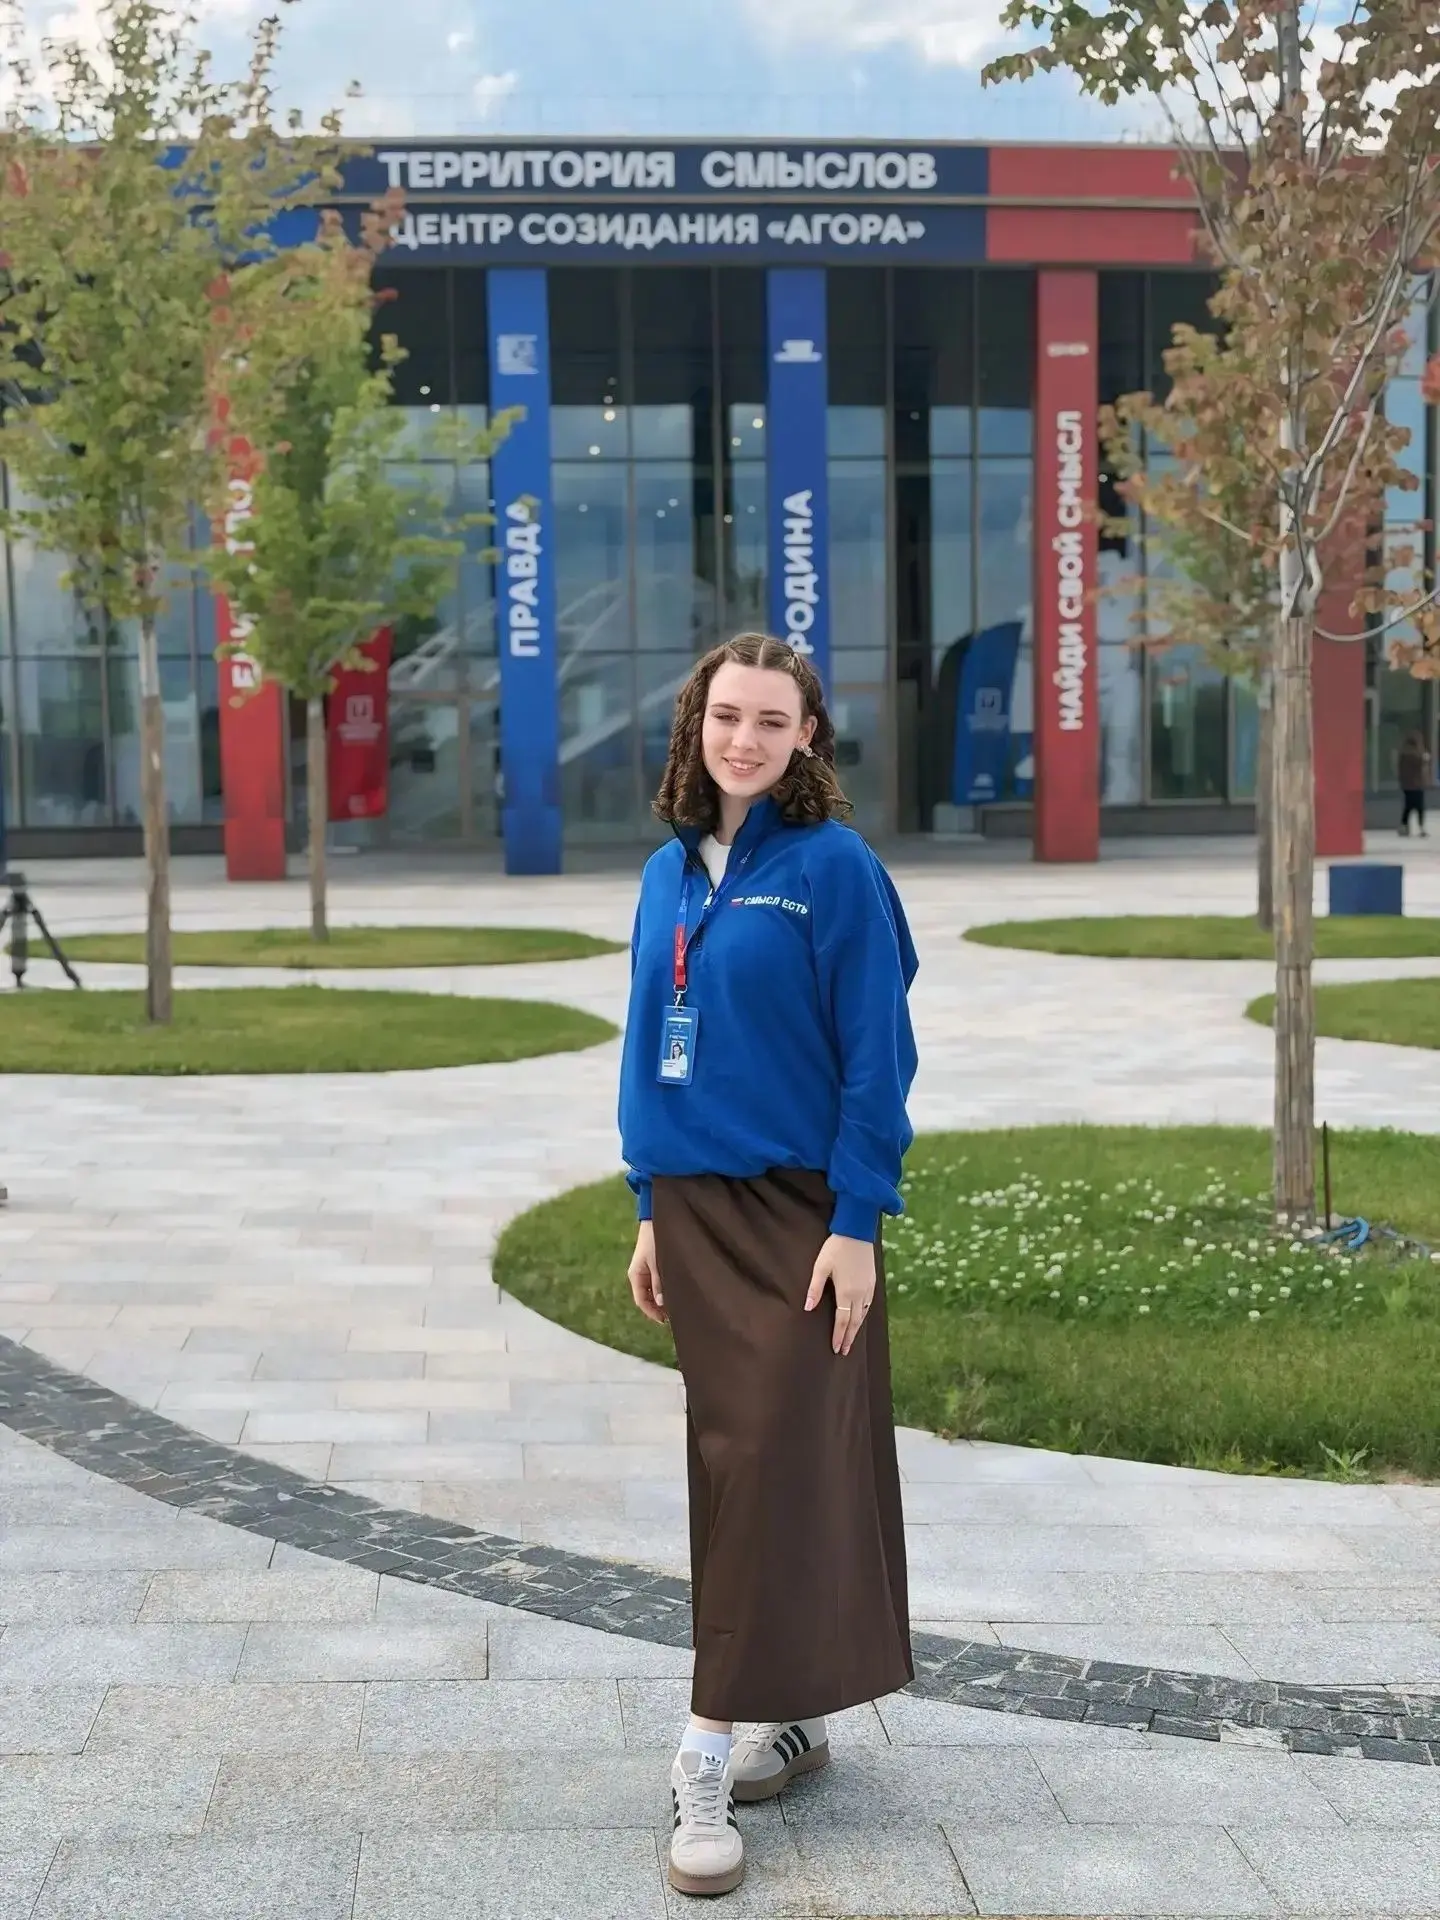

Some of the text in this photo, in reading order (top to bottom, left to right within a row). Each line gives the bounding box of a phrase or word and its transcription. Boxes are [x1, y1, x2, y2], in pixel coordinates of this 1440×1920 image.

[377, 150, 938, 189] ТЕРРИТОРИЯ СМЫСЛОВ
[388, 211, 926, 250] ЦЕНТР СОЗИДАНИЯ «АГОРА»
[506, 496, 542, 657] ПРАВДА
[783, 489, 820, 655] РОДИНА
[1052, 410, 1087, 731] НАЙДИ СВОЙ СМЫСЛ
[744, 895, 808, 915] СМЫСЛ ЕСТЬ
